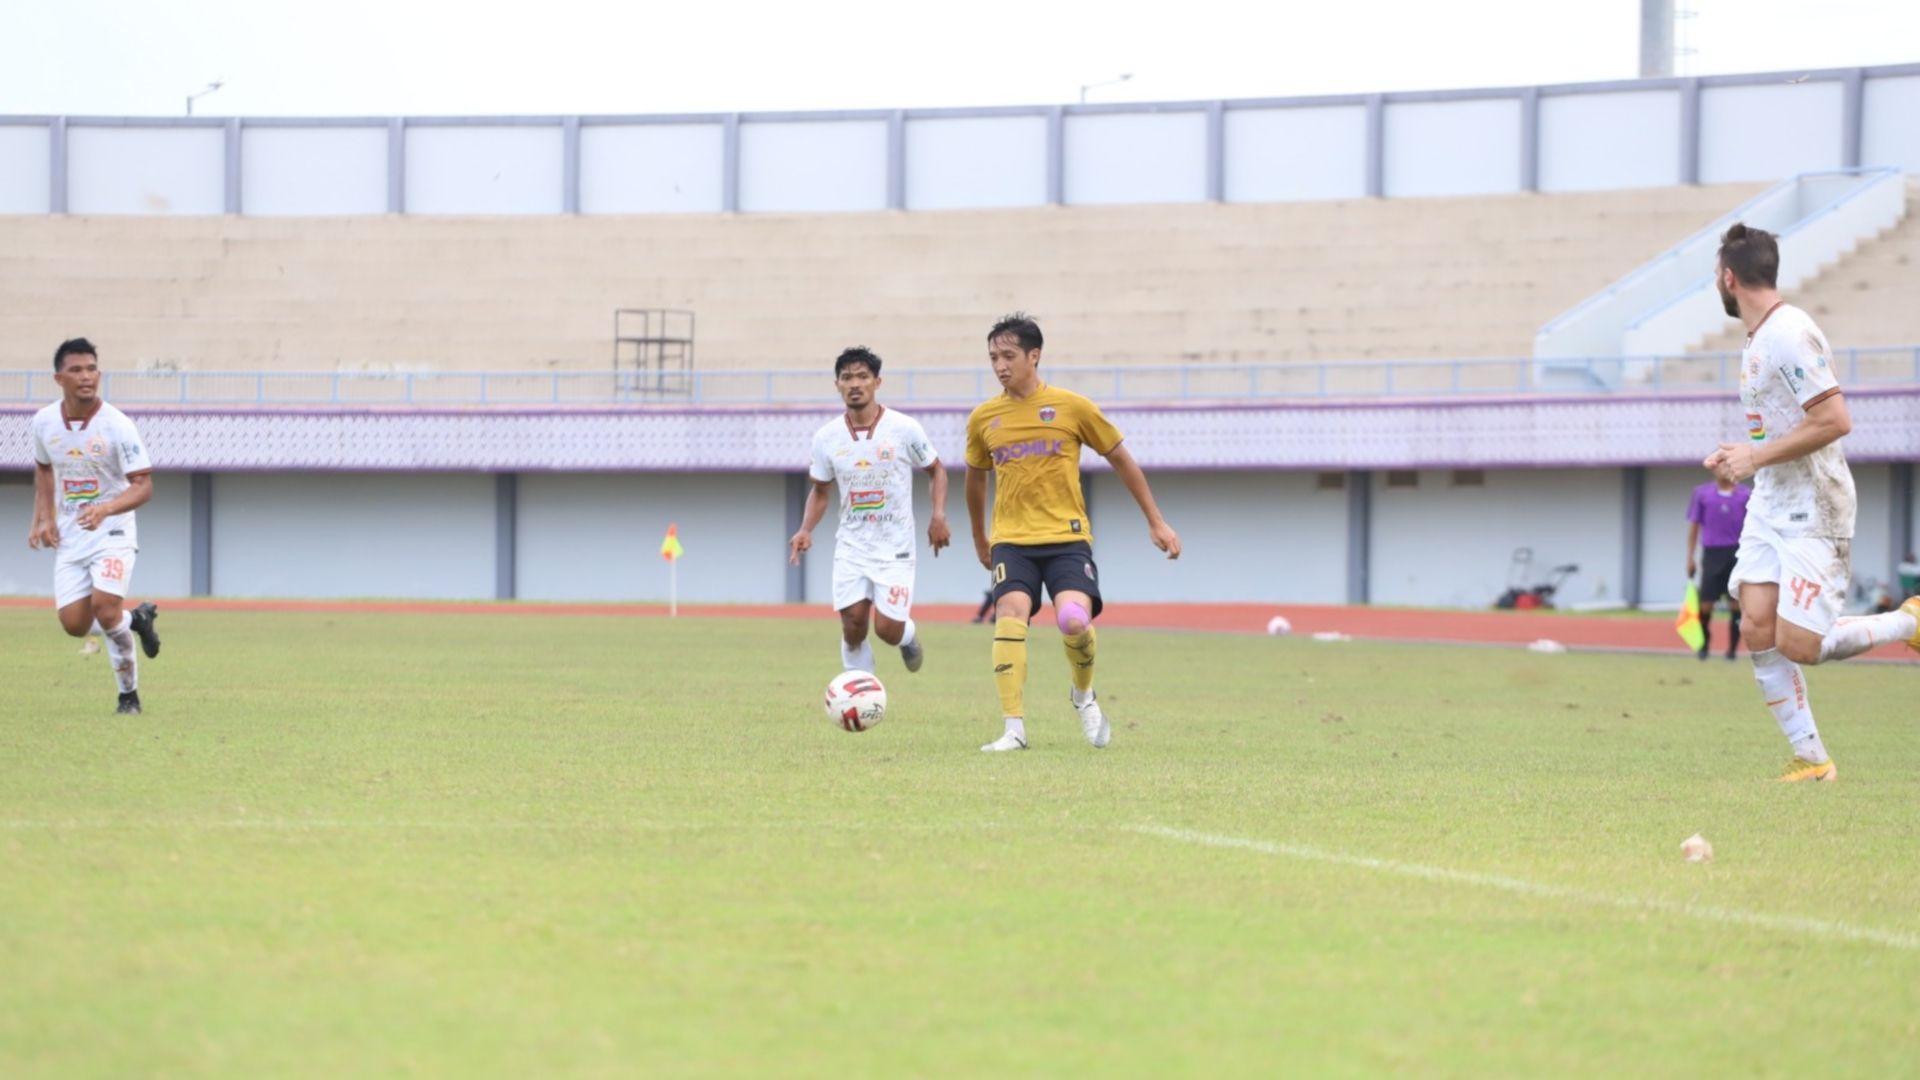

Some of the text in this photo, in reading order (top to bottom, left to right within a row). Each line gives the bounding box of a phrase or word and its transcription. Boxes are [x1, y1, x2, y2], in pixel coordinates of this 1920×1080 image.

[101, 558, 124, 581] 39
[887, 585, 910, 608] 94
[1790, 576, 1822, 610] 47
